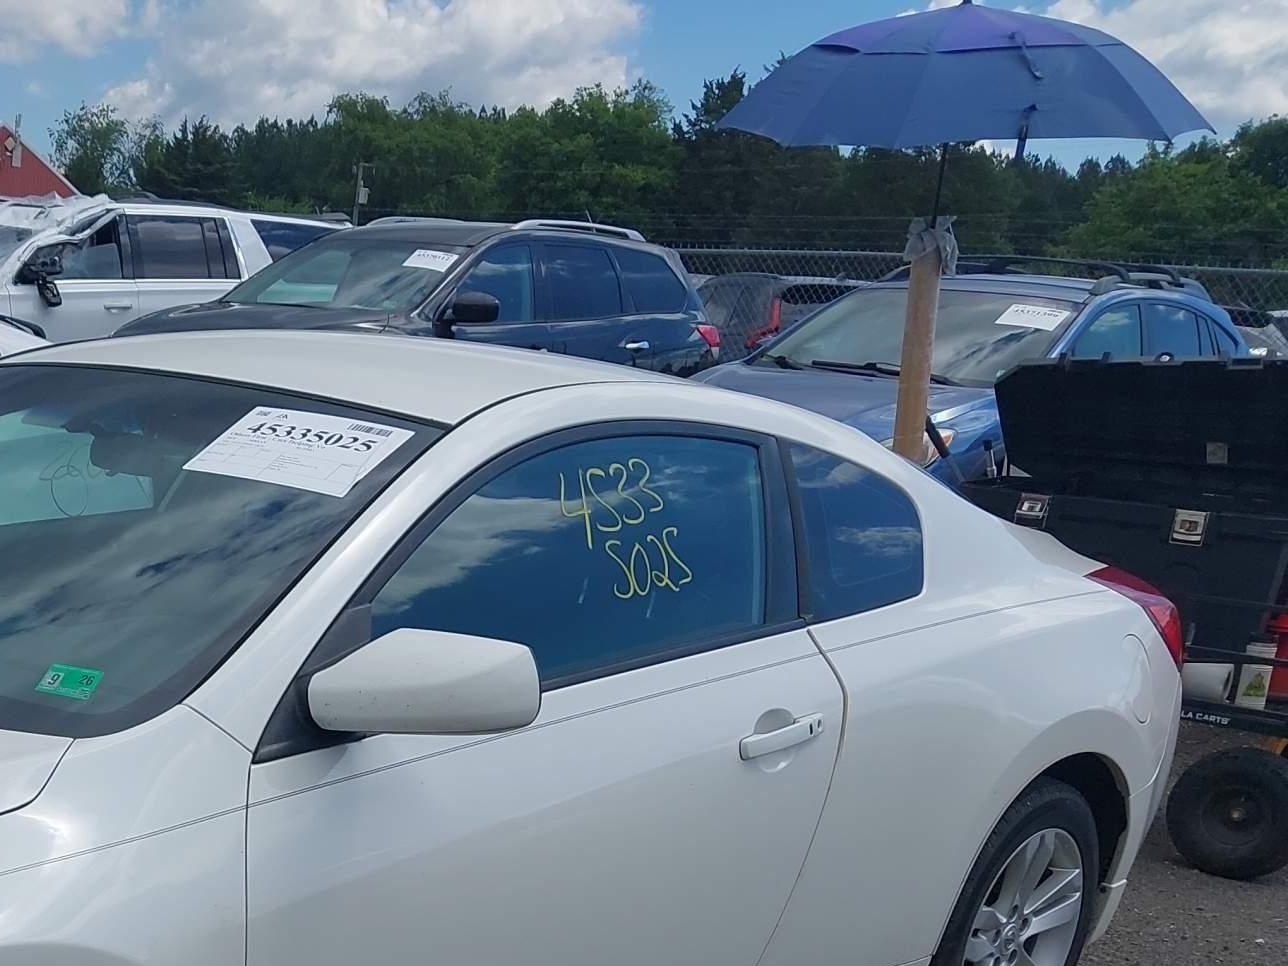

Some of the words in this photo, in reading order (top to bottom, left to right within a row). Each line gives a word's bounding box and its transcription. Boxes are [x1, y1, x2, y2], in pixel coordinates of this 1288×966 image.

[247, 421, 378, 452] 45335025
[559, 458, 664, 550] 4533
[605, 526, 693, 599] 5025
[47, 673, 61, 686] 9
